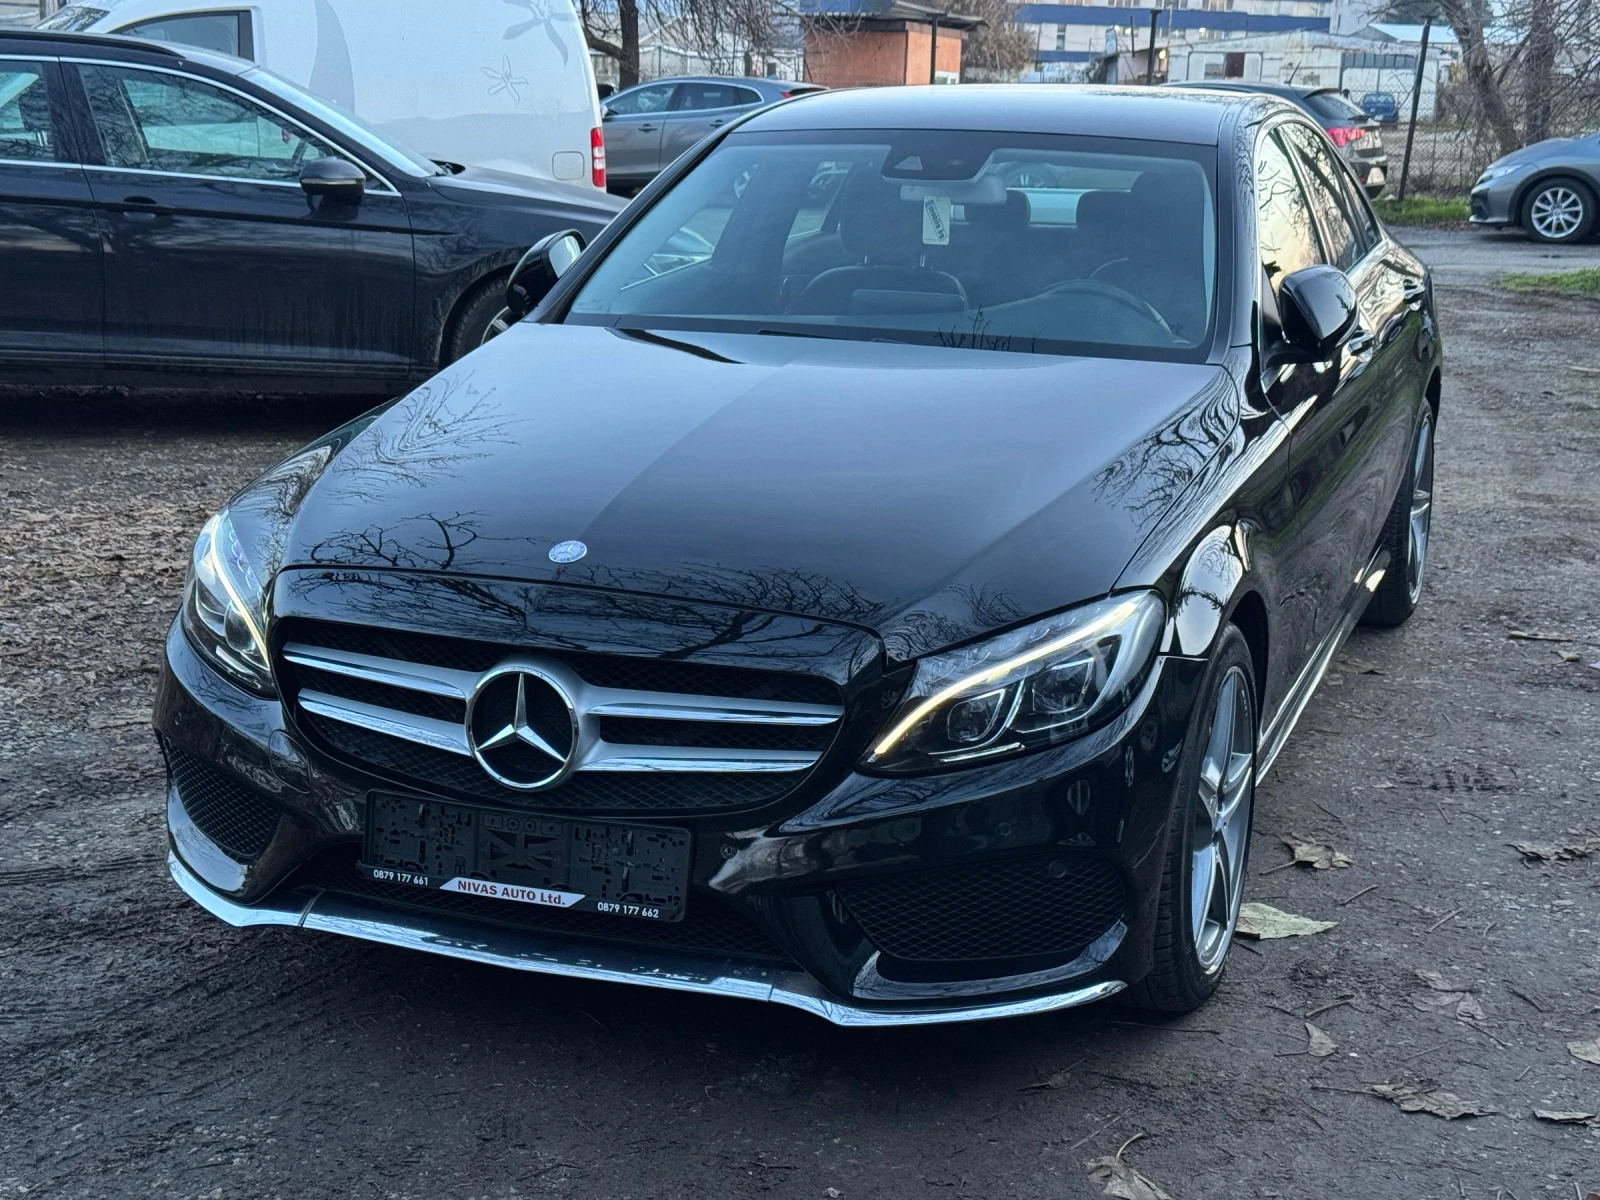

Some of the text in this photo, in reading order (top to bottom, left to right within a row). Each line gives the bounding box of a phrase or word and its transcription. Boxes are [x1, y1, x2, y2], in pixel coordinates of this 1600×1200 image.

[373, 869, 429, 886] 0879 177 661
[457, 880, 566, 905] NIVAS AUTO Ltd.
[597, 902, 659, 918] 0879 177 662
